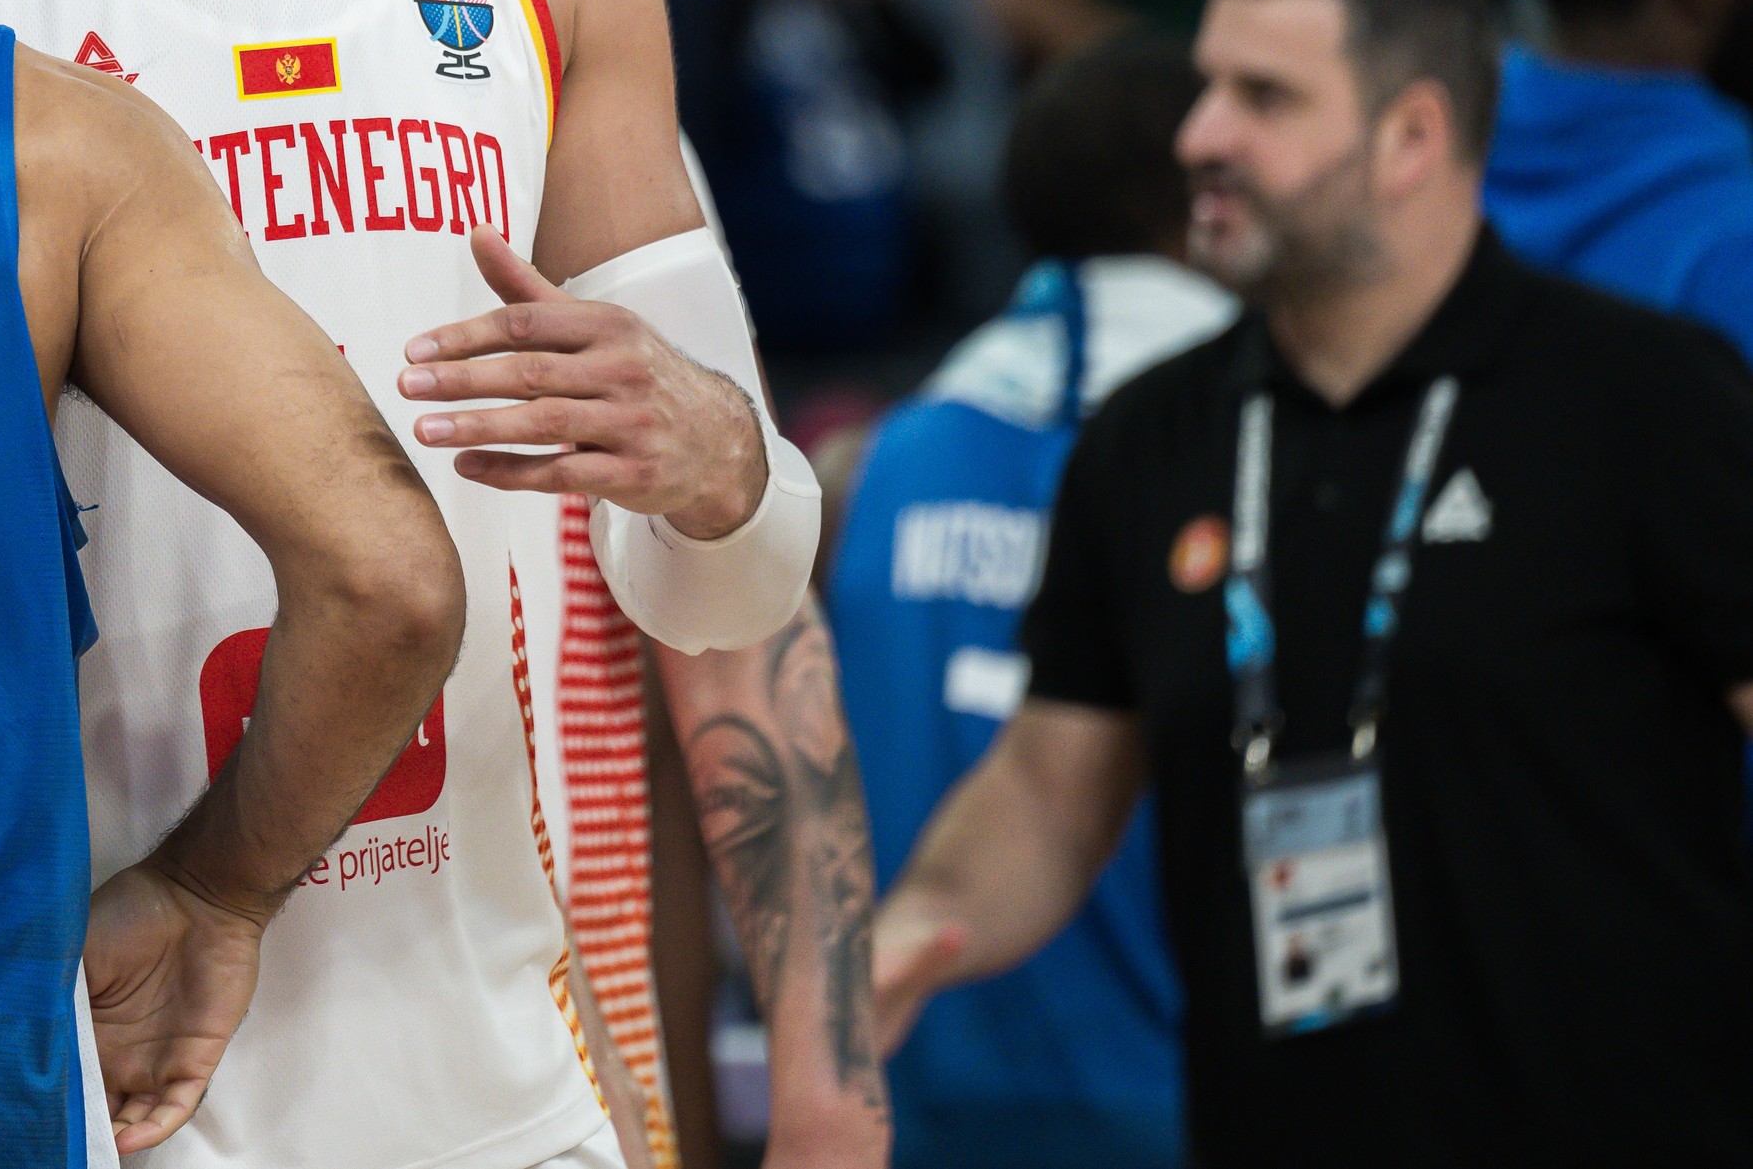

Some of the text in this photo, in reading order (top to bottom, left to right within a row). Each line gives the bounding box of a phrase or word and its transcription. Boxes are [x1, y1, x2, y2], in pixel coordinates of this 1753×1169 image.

[193, 116, 510, 245] TENEGRO
[296, 824, 451, 892] e prijatelje
